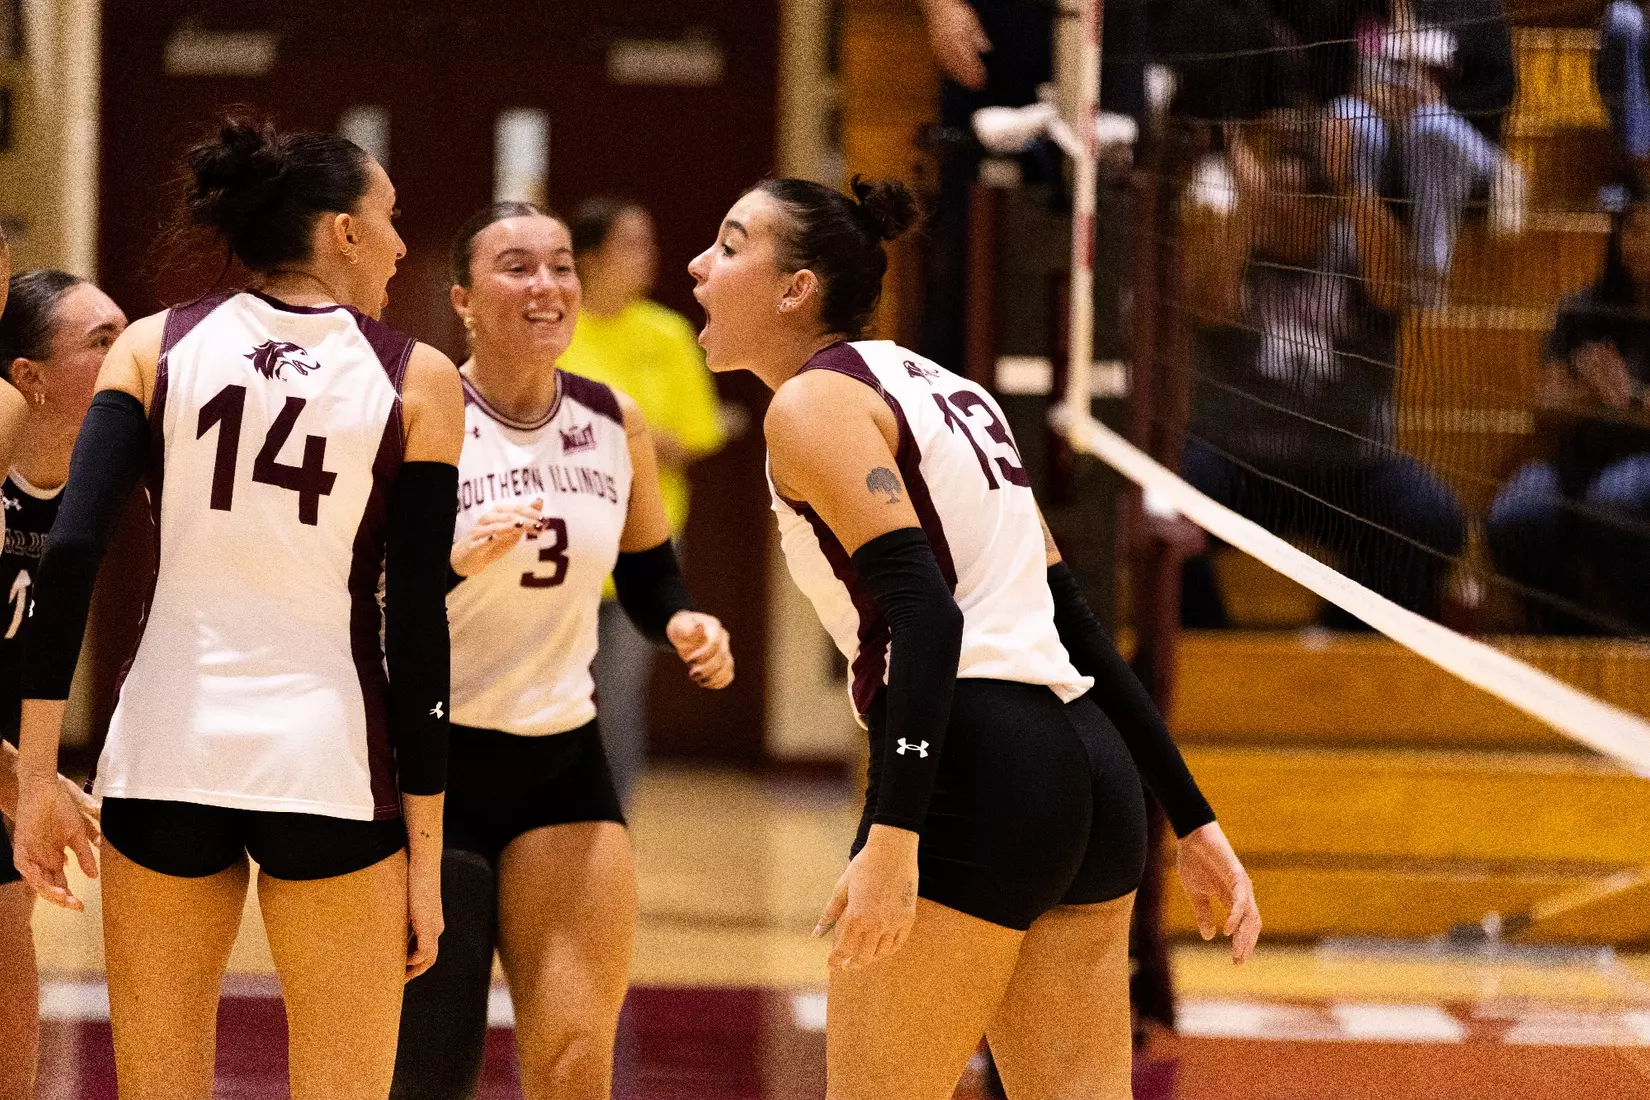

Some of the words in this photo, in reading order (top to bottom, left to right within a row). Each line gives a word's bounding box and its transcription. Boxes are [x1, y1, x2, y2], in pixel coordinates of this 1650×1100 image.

[196, 384, 337, 526] 14
[931, 390, 1031, 491] 13
[457, 468, 544, 513] OUTHERN
[548, 464, 618, 504] ILLINOIS
[520, 517, 569, 588] 3
